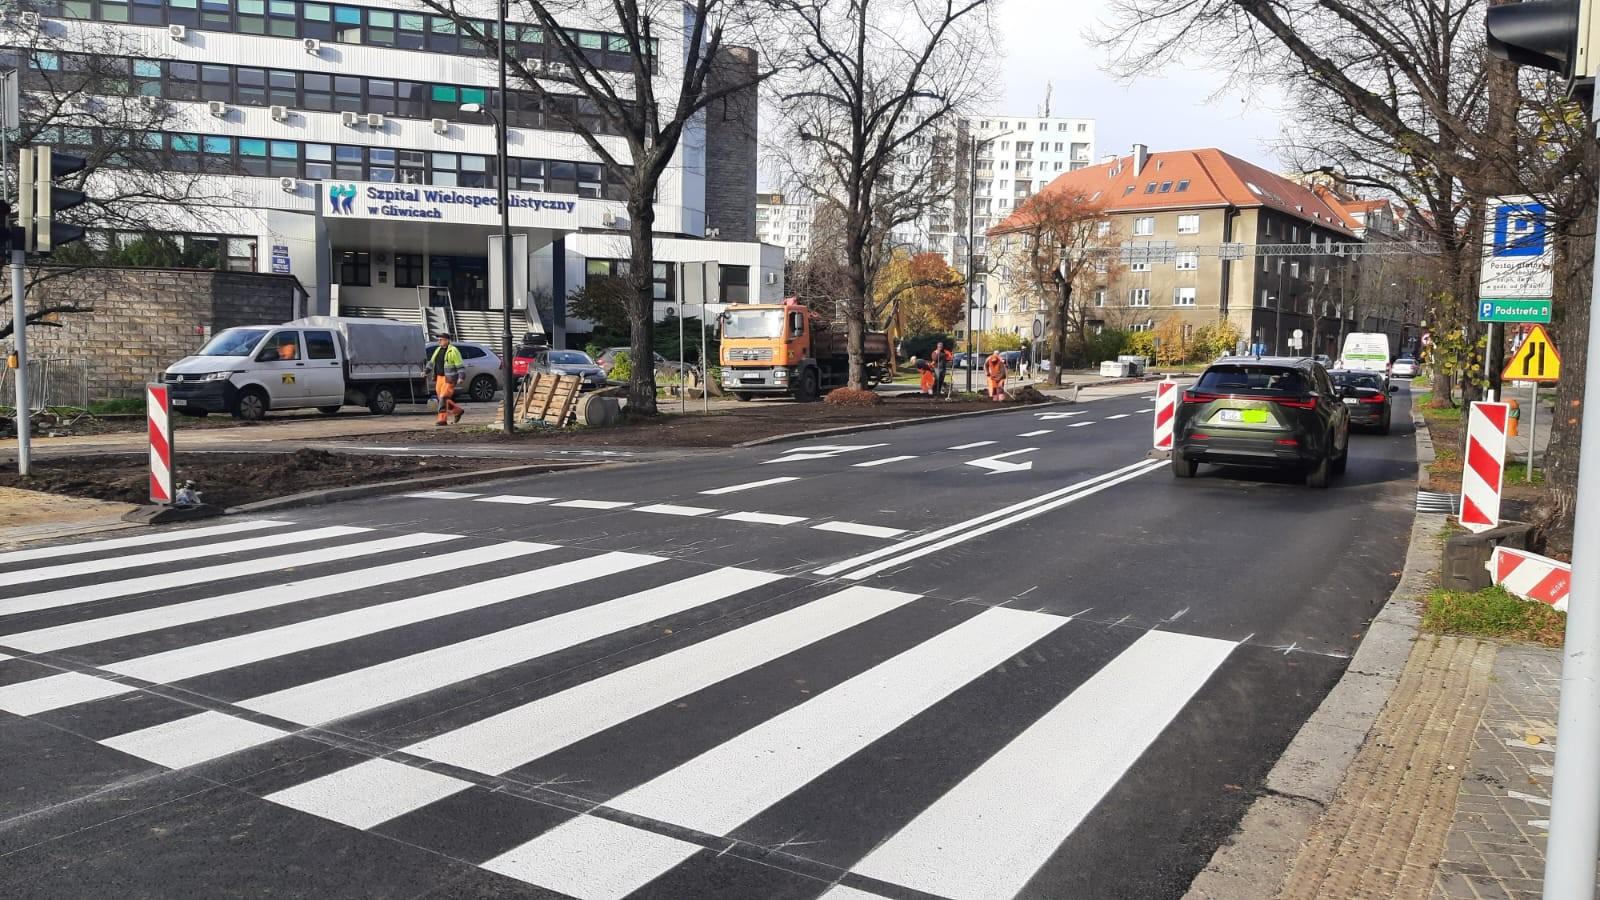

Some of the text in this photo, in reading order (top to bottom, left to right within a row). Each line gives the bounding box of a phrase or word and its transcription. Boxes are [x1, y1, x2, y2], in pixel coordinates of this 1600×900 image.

[366, 187, 575, 213] Szpital Wielospeclistyczny
[367, 205, 443, 219] w Gliwicach
[1495, 305, 1538, 315] Podstrefa
